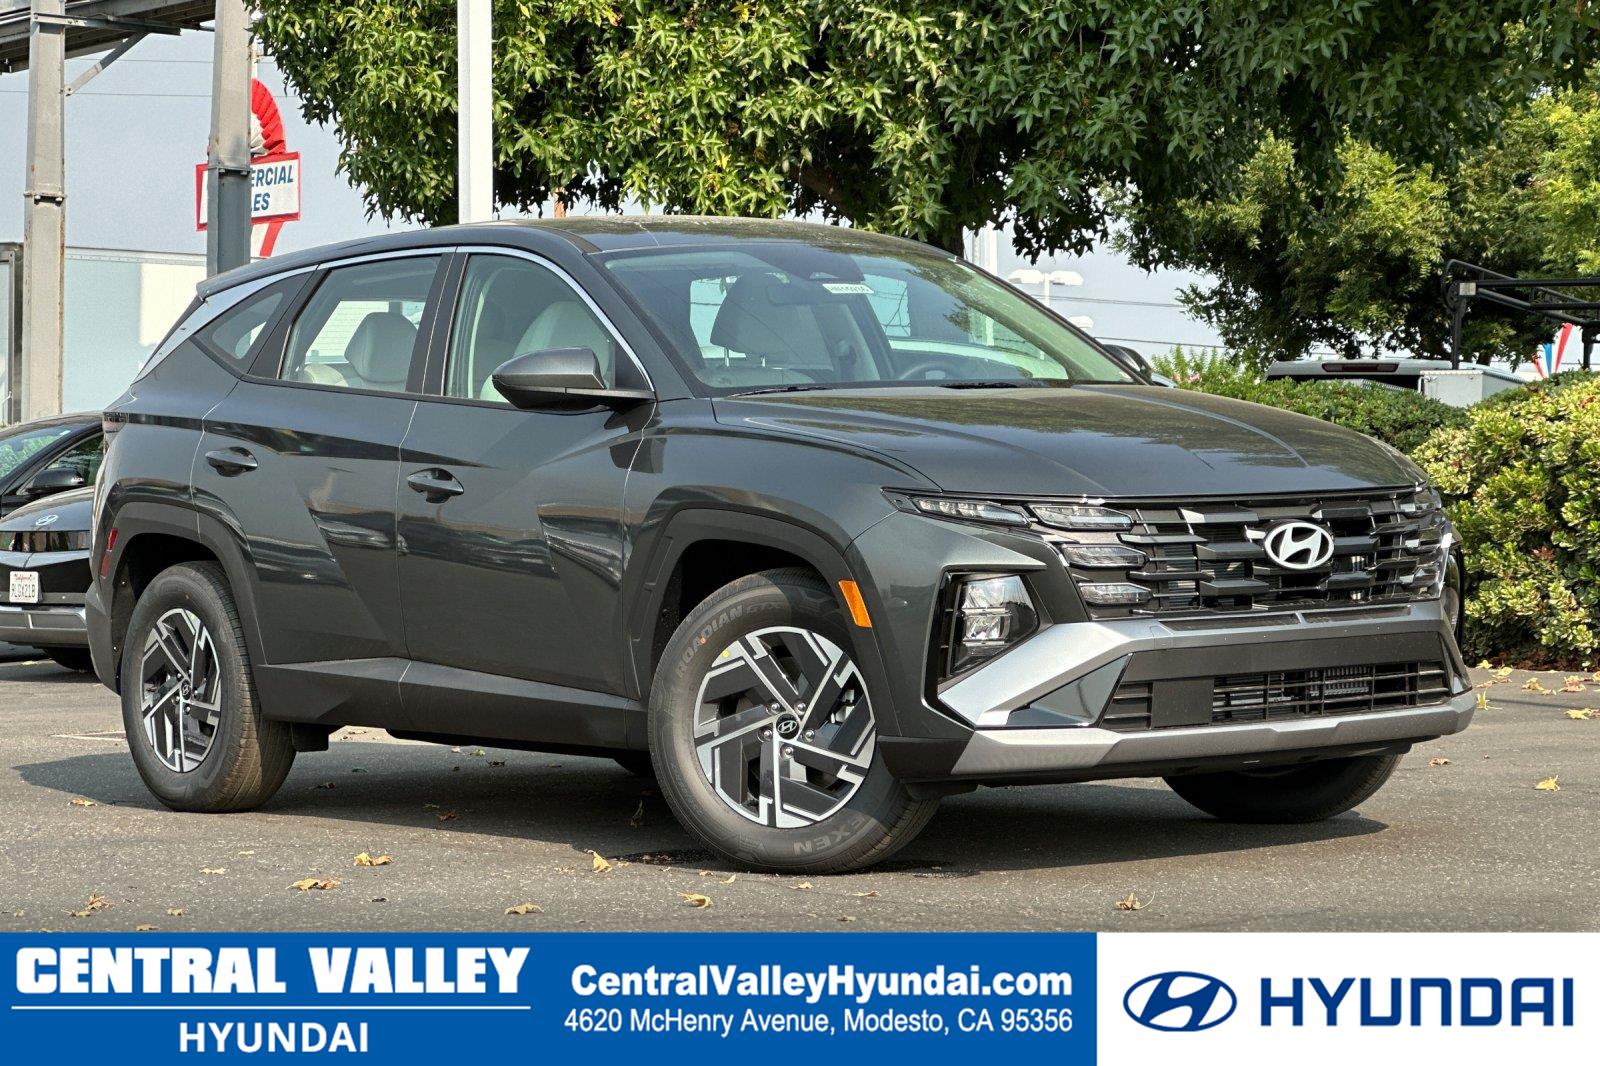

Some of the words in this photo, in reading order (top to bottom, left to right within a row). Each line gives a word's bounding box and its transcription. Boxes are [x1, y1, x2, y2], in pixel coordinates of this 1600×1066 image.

[251, 164, 294, 188] ERCIAL
[675, 604, 743, 679] ROADIAN
[793, 813, 866, 857] EXEN
